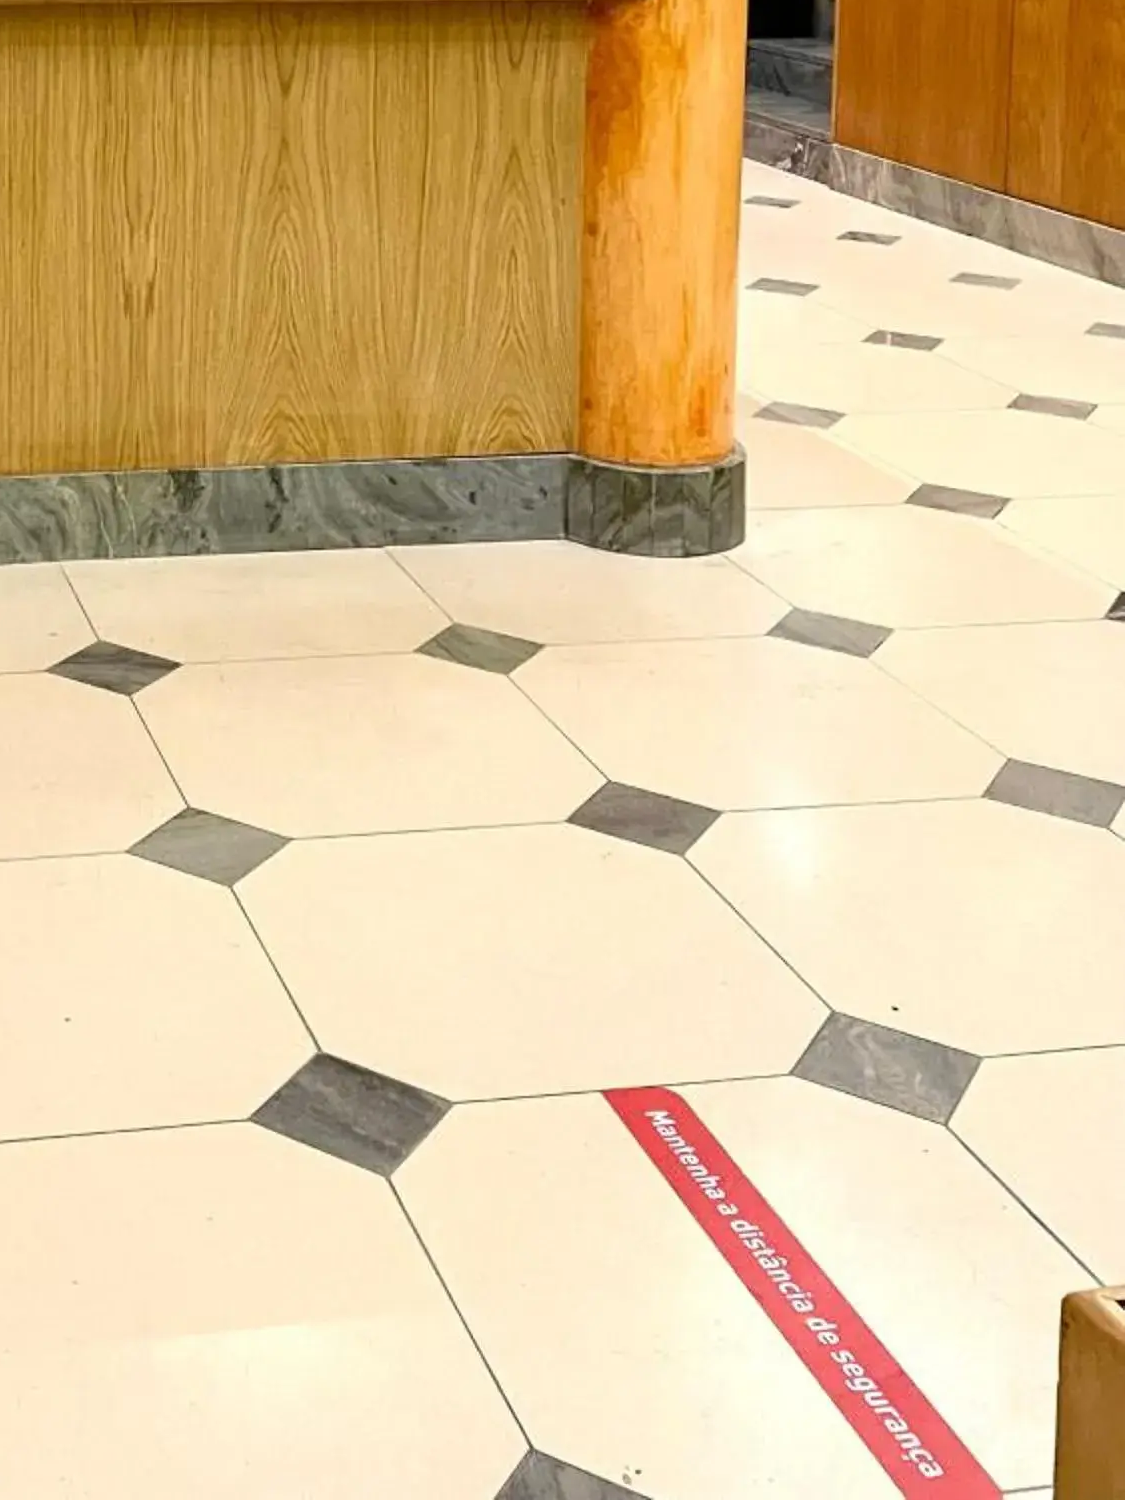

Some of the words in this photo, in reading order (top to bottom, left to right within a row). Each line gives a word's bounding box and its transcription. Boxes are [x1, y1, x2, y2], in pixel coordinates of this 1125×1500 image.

[644, 1110, 726, 1200] Mantenha
[716, 1203, 739, 1216] a
[730, 1219, 815, 1313] distância
[805, 1316, 840, 1345] de
[830, 1349, 944, 1478] segurança
